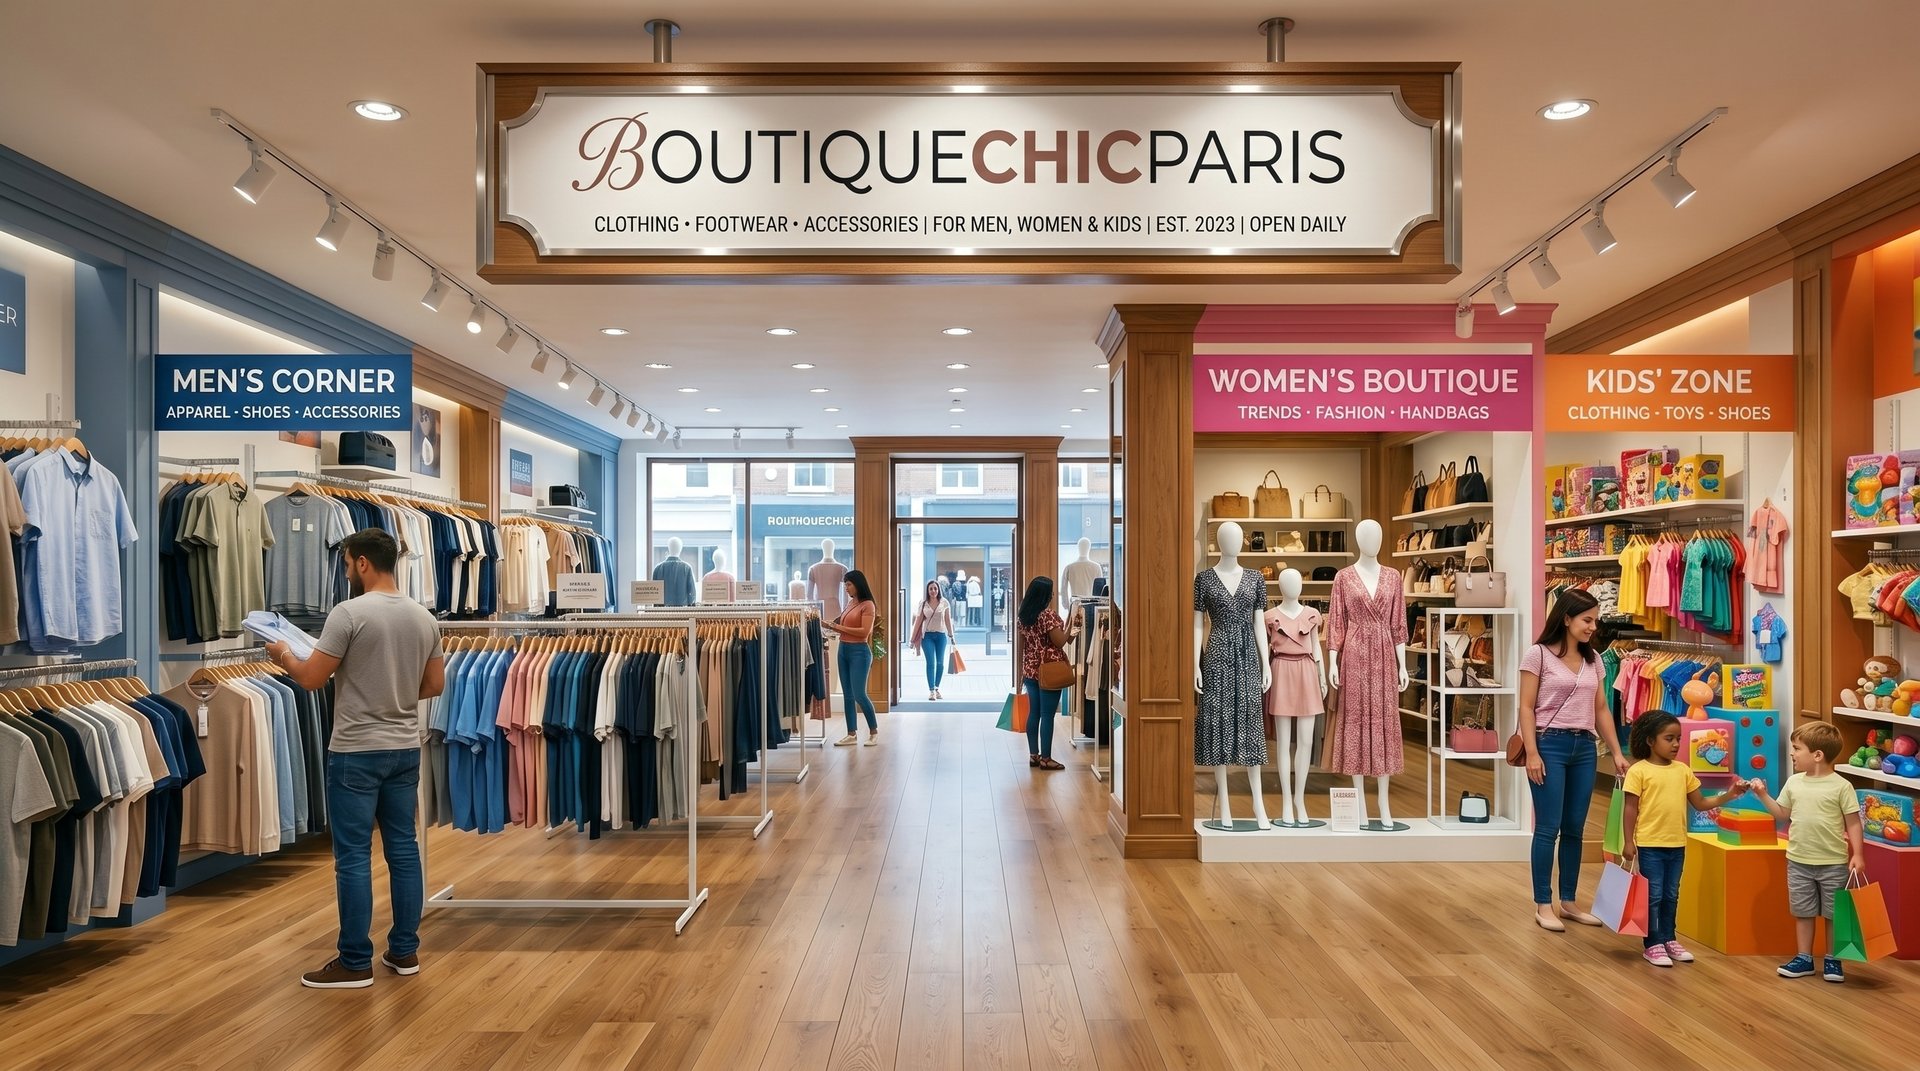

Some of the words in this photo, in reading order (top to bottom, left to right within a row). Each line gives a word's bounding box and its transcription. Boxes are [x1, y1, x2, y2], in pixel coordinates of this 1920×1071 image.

[594, 215, 679, 233] CLOTHING
[695, 215, 788, 233] FOOTWEAR
[803, 215, 919, 233] ACCESSORIES
[933, 215, 966, 233] FOR
[971, 215, 1012, 236] MEN,
[1017, 215, 1082, 233] WOMEN
[1087, 215, 1099, 233] &
[1104, 215, 1142, 233] KIDS
[1156, 215, 1189, 233] EST.
[1195, 215, 1235, 233] 2023
[1249, 215, 1295, 233] OPEN
[1301, 215, 1347, 233] DAILY
[173, 368, 264, 393] MEN'S
[272, 368, 395, 393] CORNER
[1208, 368, 1356, 393] WOMEN'S
[1364, 368, 1518, 396] BOUTIQUE
[1587, 369, 1662, 393] KIDS'
[1670, 369, 1752, 394] ZONE
[166, 405, 231, 419] APPAREL
[242, 405, 291, 419] SHOES
[302, 405, 401, 419] ACCESSORIES
[1237, 405, 1302, 420] TRENDS
[1315, 405, 1386, 420] FASHION
[1399, 405, 1490, 420] HANDBAGS
[1567, 405, 1651, 420] CLOTHING
[1662, 406, 1705, 420] TOYS
[1718, 406, 1771, 420] SHOES
